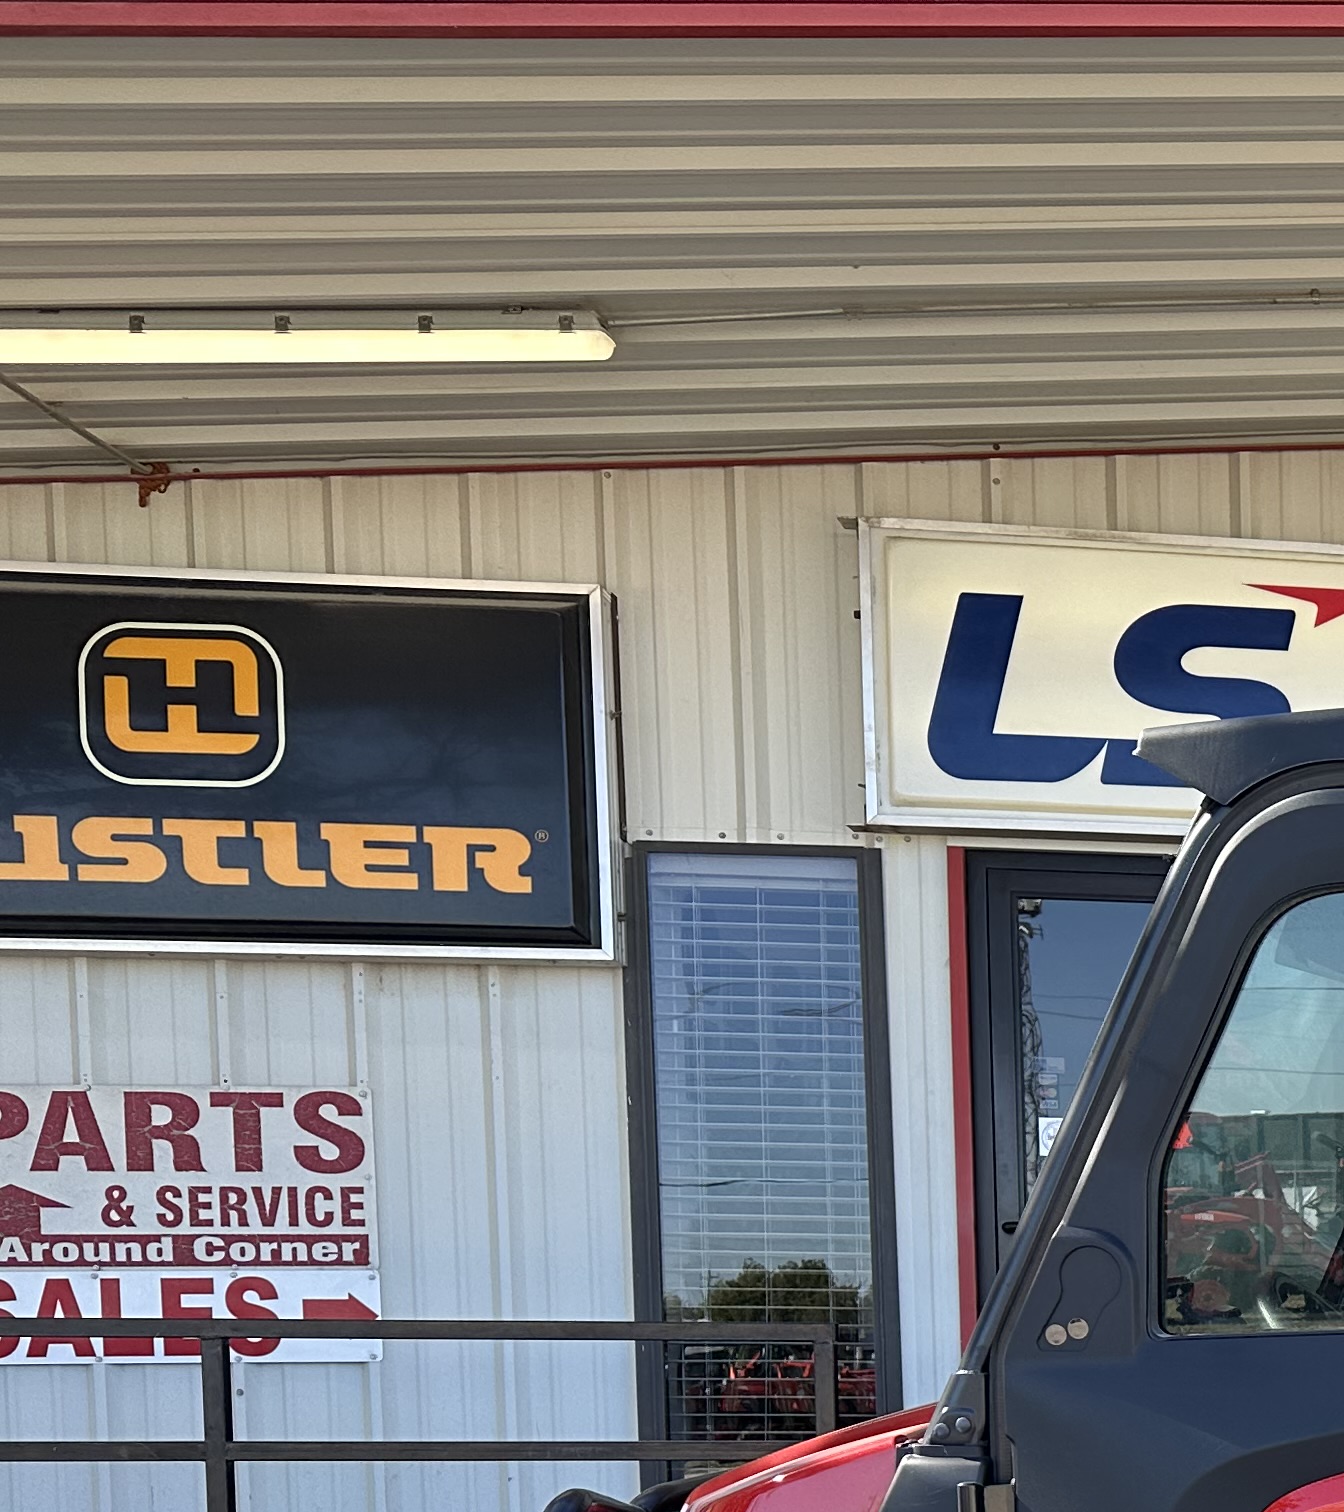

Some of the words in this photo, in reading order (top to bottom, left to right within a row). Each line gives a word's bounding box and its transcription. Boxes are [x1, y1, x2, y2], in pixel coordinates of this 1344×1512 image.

[927, 592, 1297, 787] LS
[101, 1185, 137, 1228] &
[156, 1185, 366, 1228] SERVICE
[0, 1236, 174, 1263] Around
[193, 1236, 361, 1263] Corner
